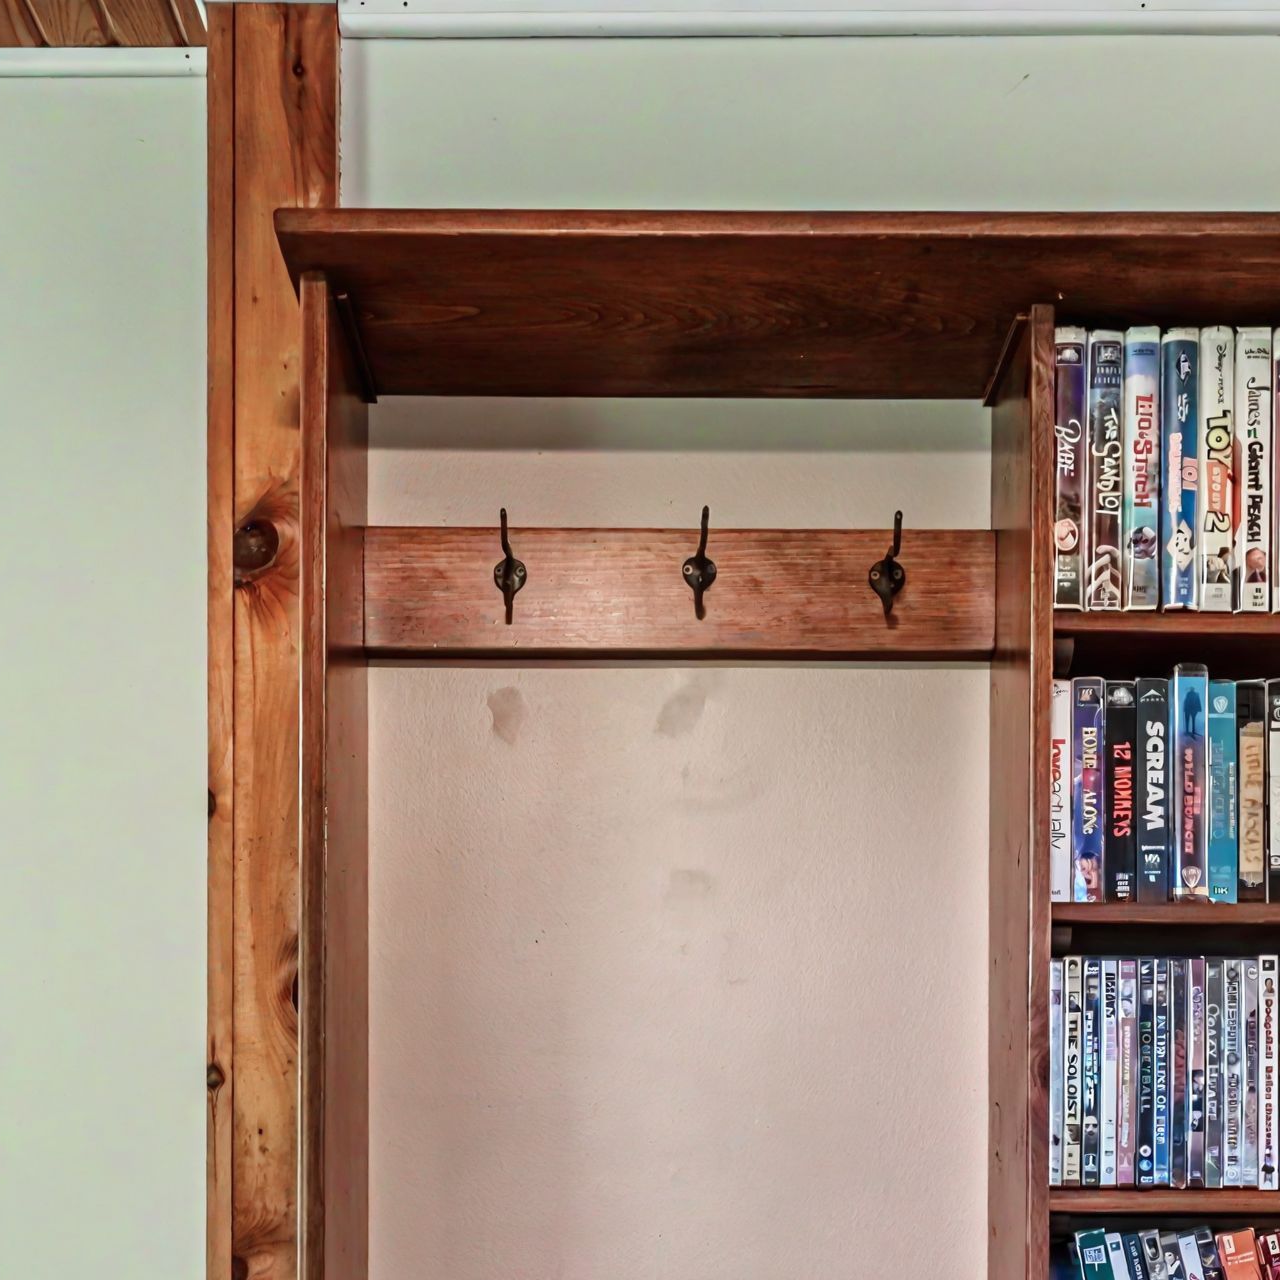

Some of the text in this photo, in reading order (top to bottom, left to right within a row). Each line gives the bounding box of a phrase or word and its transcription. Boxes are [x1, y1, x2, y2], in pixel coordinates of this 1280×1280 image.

[1206, 410, 1231, 466] TOY
[1142, 720, 1164, 830] SCREAM
[1067, 1019, 1078, 1120] THE SOLOIST
